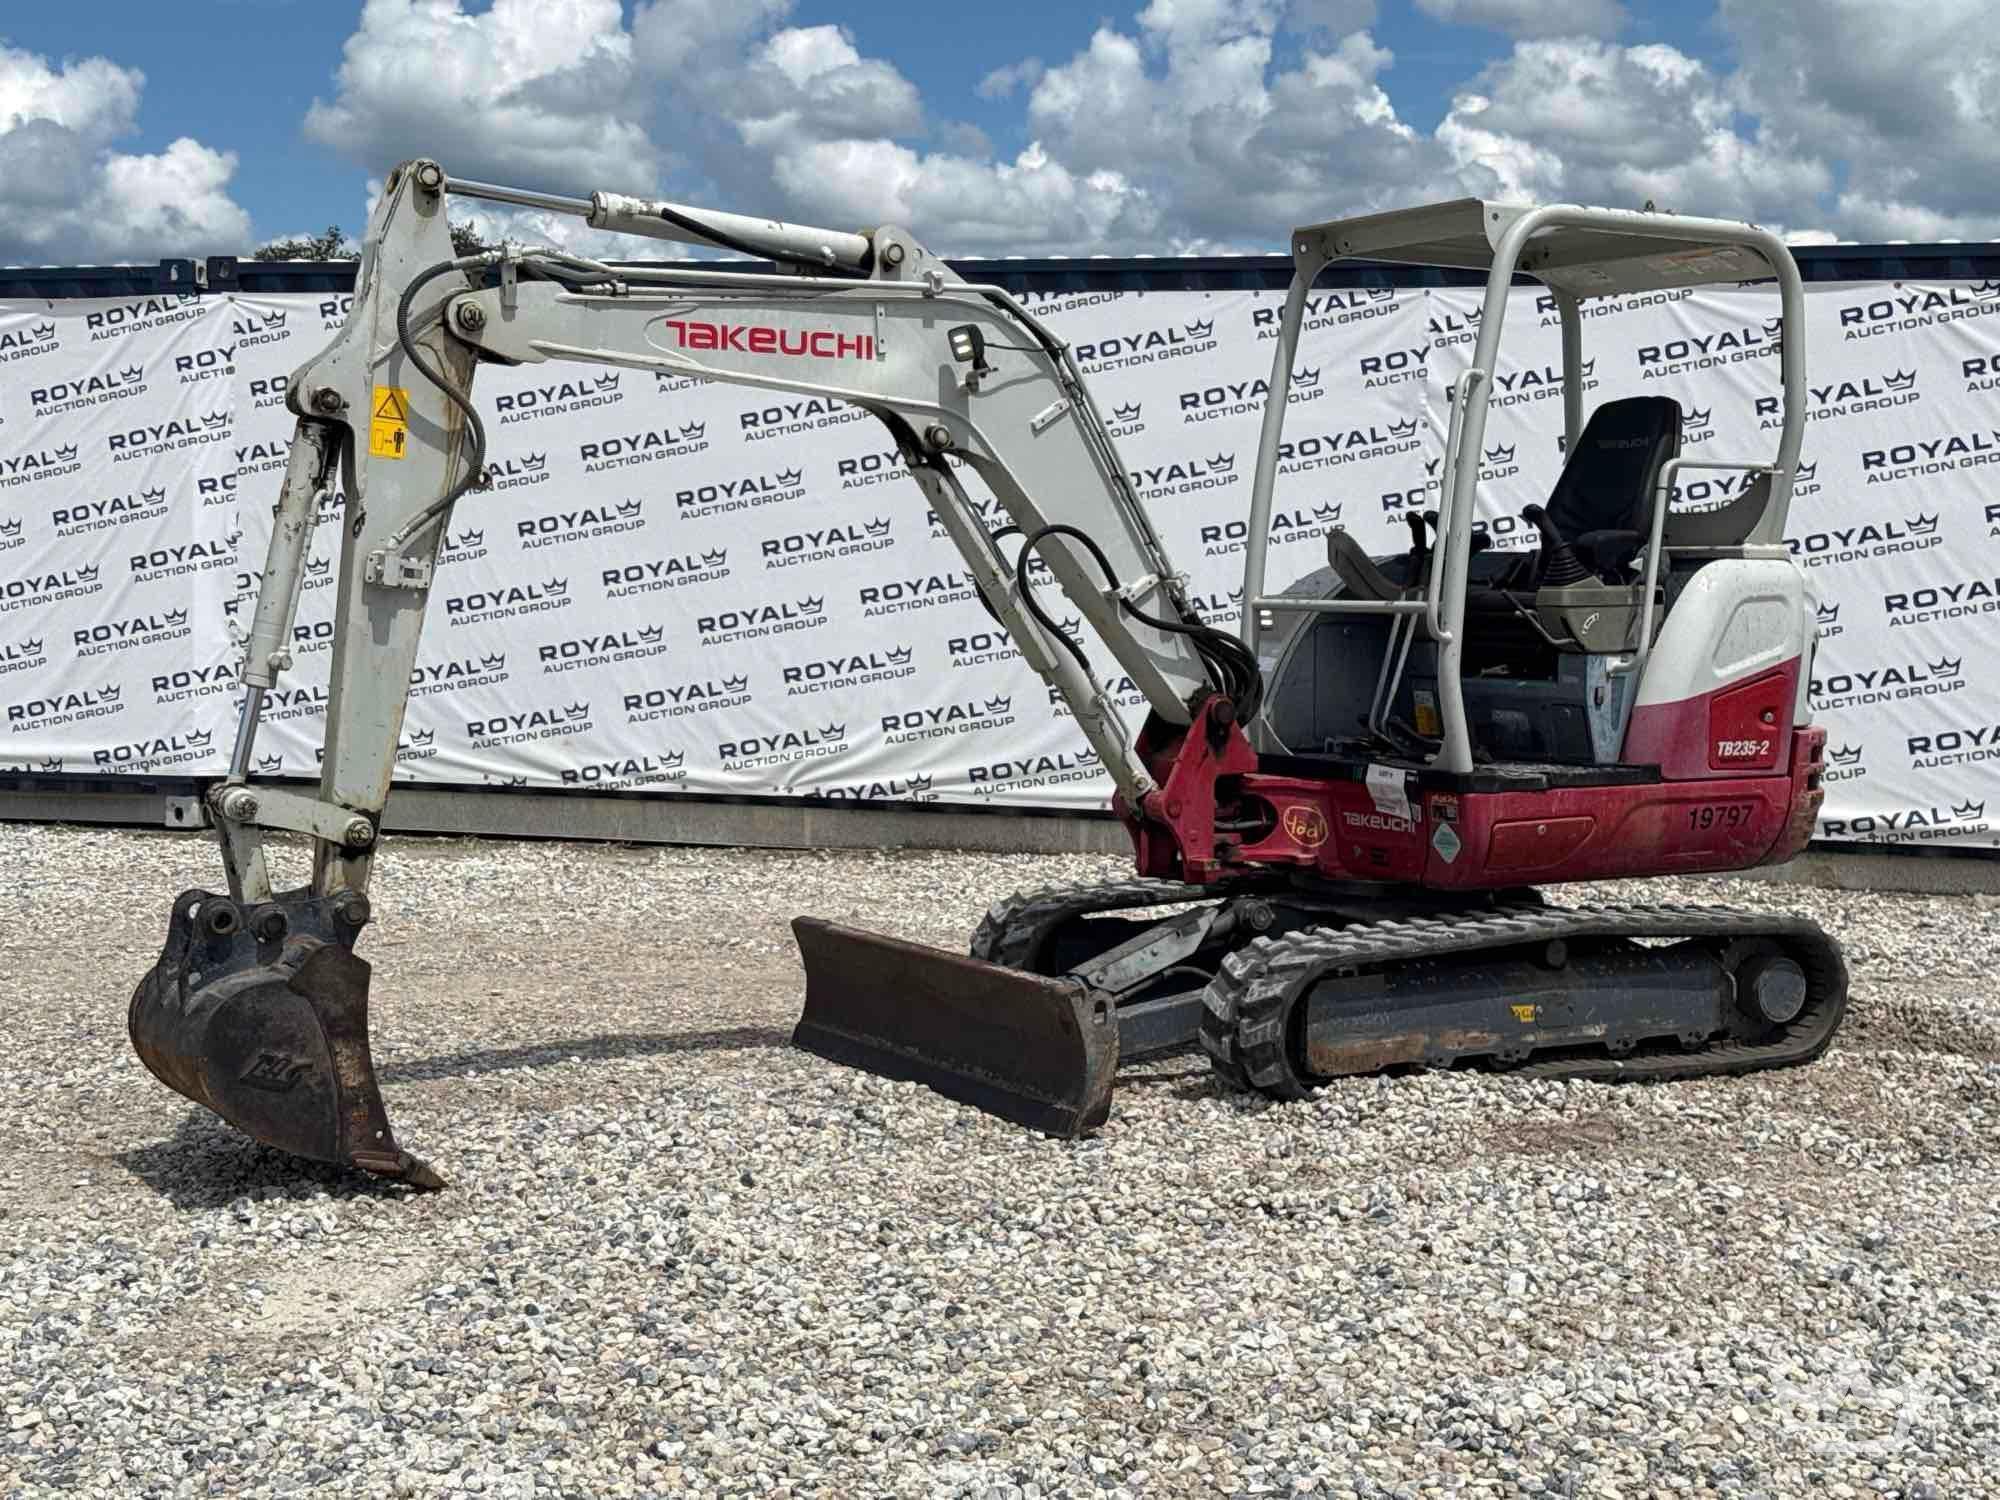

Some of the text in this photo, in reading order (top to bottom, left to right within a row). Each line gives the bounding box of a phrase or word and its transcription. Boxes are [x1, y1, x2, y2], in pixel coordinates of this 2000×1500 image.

[86, 296, 178, 329] ROYAL
[1066, 292, 1123, 309] GROUP
[1540, 289, 1693, 327] AUTION GROUP
[1840, 288, 1971, 326] ROYAL
[91, 308, 205, 341] AUCTION GROUP
[1257, 304, 1400, 340] AUION GROUP
[1845, 316, 1933, 340] AUCTION
[11, 342, 60, 360] GROUP
[240, 330, 290, 348] GROUP
[1076, 328, 1186, 362] ROYAL
[1638, 328, 1763, 365] ROYAL
[175, 344, 235, 372] ROY
[1081, 341, 1217, 375] AUCTION GROUP
[1360, 345, 1430, 375] ROY
[1643, 355, 1727, 379] AUCTION
[31, 373, 121, 405] ROYAL
[1365, 368, 1428, 389] AUCTIO
[35, 385, 147, 417] AUCTION GROUP
[496, 381, 595, 412] ROYAL
[500, 393, 623, 424] AUCTION GROUP
[1179, 379, 1272, 410] ROYA
[1184, 389, 1324, 423] AUCTION OUP
[1487, 393, 1530, 408] TION
[1755, 379, 1884, 416] RYAL
[740, 397, 843, 429] ROYAL
[1760, 392, 1920, 430] AUTION GROUP
[109, 418, 201, 450] ROYAL
[581, 429, 680, 460] ROYAL
[745, 421, 814, 441] AUCTION
[1111, 424, 1145, 437] OUP
[1273, 427, 1389, 461] ROYAL
[113, 430, 227, 463] AUCTION GROUP
[230, 442, 285, 463] YAL
[585, 442, 709, 473] AUCTION GROUP
[1278, 440, 1421, 475] AUCTION GROUP
[1862, 433, 1994, 469] ROYAL
[0, 463, 81, 488] TION GROUP
[3, 451, 56, 473] YAL
[838, 449, 901, 476] ROY
[1482, 466, 1519, 480] OUP
[1867, 452, 2000, 484] AUCTION GRO
[498, 473, 550, 490] GROUP
[676, 476, 776, 507] ROYAL
[1136, 475, 1238, 501] TION GROUP
[52, 495, 142, 526] ROYAL
[681, 489, 805, 520] AUCTION GROUP
[57, 506, 168, 538] AUCTION GROUP
[517, 507, 617, 537] ROYAL
[522, 519, 645, 550] AUCTION GROUP
[1201, 511, 1313, 543] ROAL
[761, 525, 864, 556] ROYAL
[766, 538, 894, 569] AUCTION GROUP
[1205, 535, 1281, 556] AUCTN
[1809, 537, 1943, 567] CTION GROUP
[128, 540, 225, 571] ROYAL
[134, 556, 233, 583] AUCTION GRO
[437, 549, 487, 565] GROUP
[304, 577, 334, 589] OUP
[603, 556, 702, 586] ROYAL
[607, 569, 731, 598] AUCTION GROUP
[0, 583, 103, 611] UCTION GROUP
[446, 585, 543, 614] ROYAL
[860, 573, 964, 604] ROYAL
[1884, 581, 1993, 612] ROYA
[451, 598, 571, 626] AUCTION GROUP
[697, 603, 798, 633] ROYAL
[865, 597, 935, 617] AUCTION
[1890, 605, 1978, 627] AUCTION
[73, 616, 165, 645] ROYAL
[78, 627, 191, 657] AUCTION GROUP
[702, 616, 827, 646] AUCTION GROUP
[948, 628, 1011, 655] ROY
[539, 632, 638, 662] ROYAL
[544, 645, 667, 674] AUCTION GROUP
[953, 648, 1023, 667] AUCTION
[406, 660, 481, 685] OYAL
[783, 653, 886, 684] ROYAL
[787, 666, 916, 696] AUCTION GROUP
[155, 684, 222, 704] AUCTION
[410, 673, 509, 698] CTION GROUP
[624, 682, 723, 711] ROYAL
[1896, 680, 1965, 699] GROUP
[8, 691, 98, 721] ROYAL
[12, 703, 124, 732] AUCTION GROUP
[259, 708, 302, 723] CTION
[629, 695, 752, 723] AUCTION GROUP
[881, 702, 985, 732] ROYAL
[467, 709, 565, 738] ROYAL
[472, 722, 593, 750] AUCTION GROUP
[885, 716, 1015, 745] AUCTION GROUP
[93, 737, 186, 765] ROYAL
[397, 749, 437, 761] ROUP
[718, 730, 820, 759] ROYAL
[1717, 740, 1770, 757] TB235-2
[1907, 726, 1987, 755] ROY
[164, 748, 213, 764] GROUP
[723, 744, 848, 771] AUCTION GROUP
[969, 754, 1075, 783] ROYAL
[560, 758, 659, 784] ROYAL
[635, 770, 687, 785] GROUP
[974, 768, 1105, 796] AUCTION GROUP
[1689, 804, 1755, 831] 19797
[1823, 809, 1952, 837] ROYAL
[1920, 823, 1989, 839] GROUP
